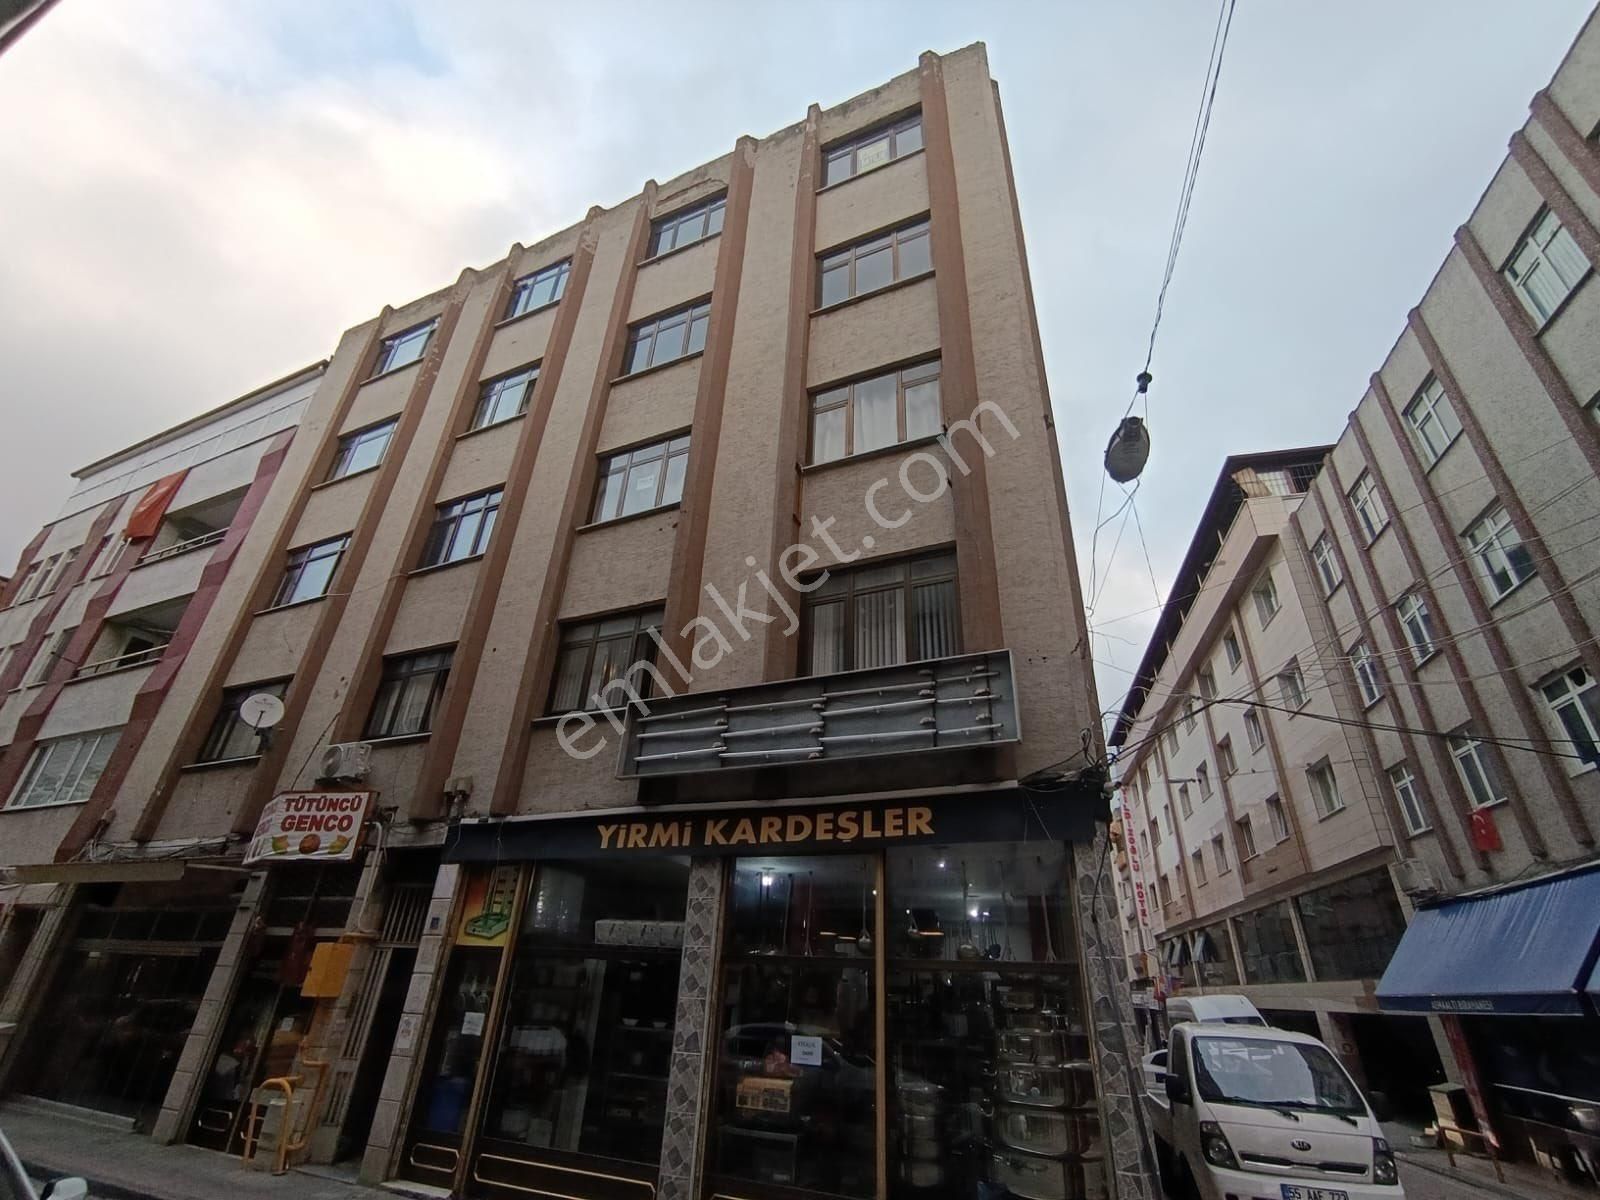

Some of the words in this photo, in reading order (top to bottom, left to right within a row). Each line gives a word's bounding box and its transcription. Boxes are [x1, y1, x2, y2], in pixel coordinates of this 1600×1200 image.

[284, 795, 363, 812] TÜTÜNCÜ
[281, 814, 354, 832] GENCO
[704, 807, 935, 843] KARDEŞLER
[1135, 882, 1149, 927] HOTEL
[1288, 1187, 1301, 1200] 55
